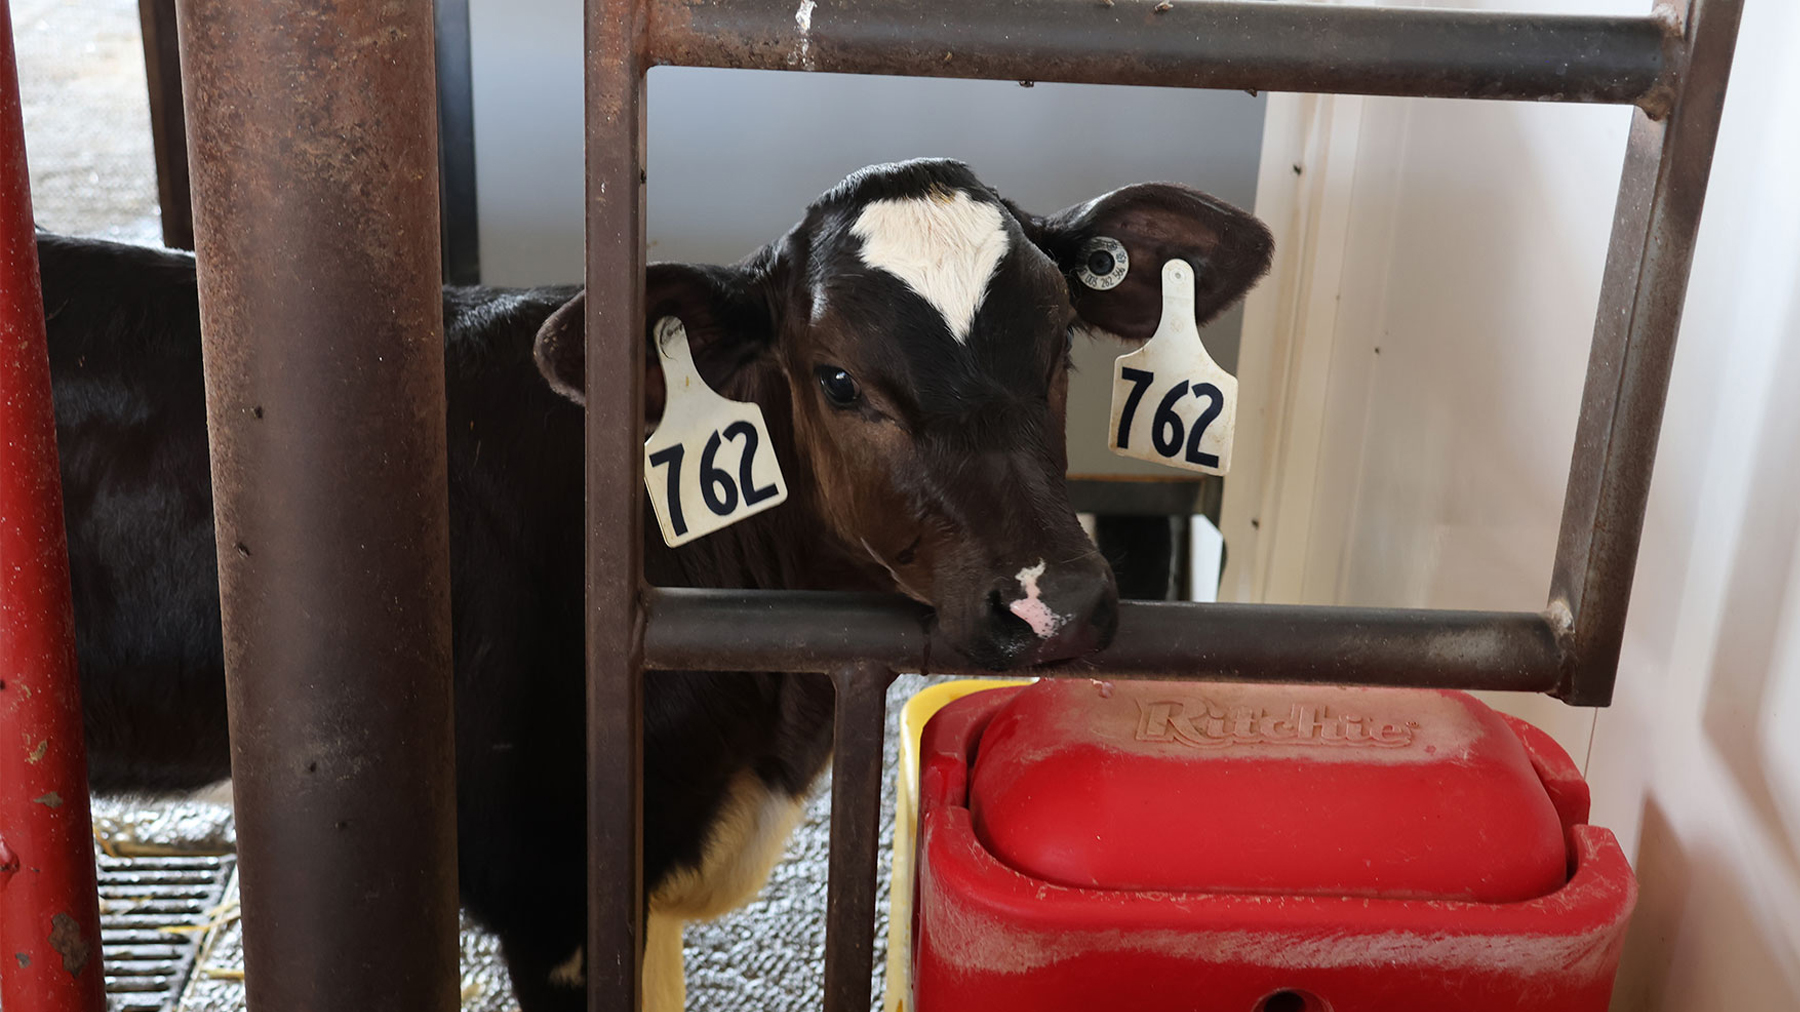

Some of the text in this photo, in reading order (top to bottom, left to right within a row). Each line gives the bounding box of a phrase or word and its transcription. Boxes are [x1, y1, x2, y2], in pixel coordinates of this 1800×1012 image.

[1117, 366, 1224, 469] 762
[648, 420, 780, 537] 762
[1135, 697, 1413, 748] Ritchie
